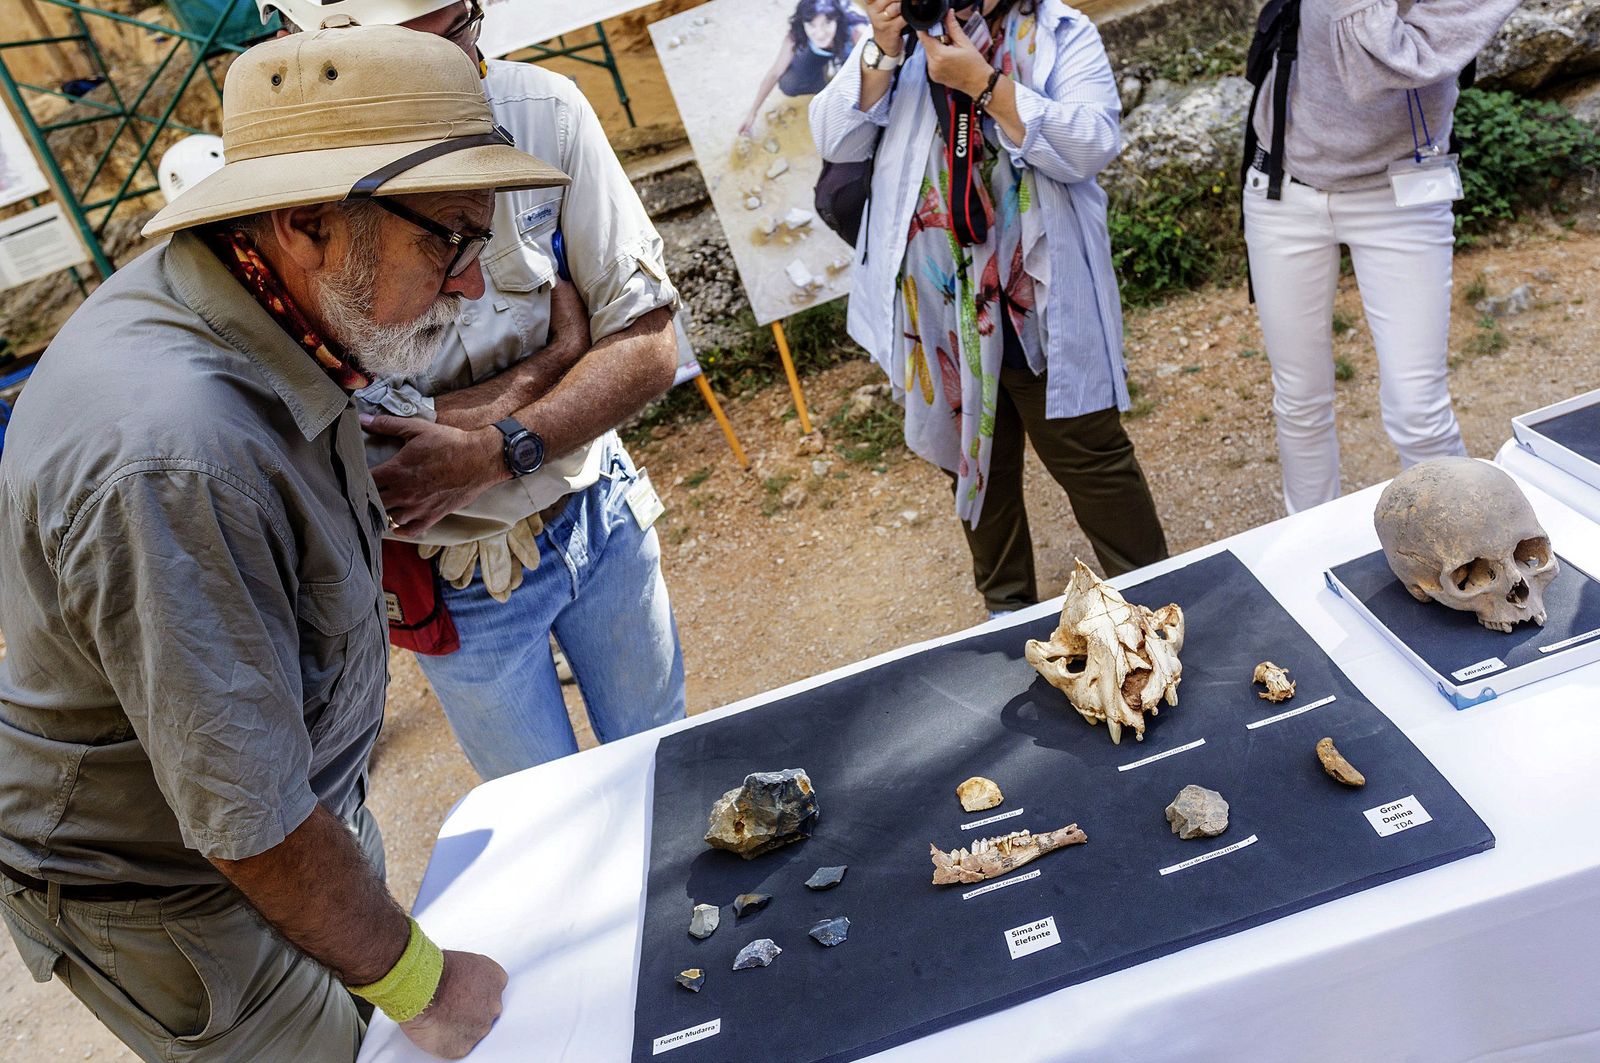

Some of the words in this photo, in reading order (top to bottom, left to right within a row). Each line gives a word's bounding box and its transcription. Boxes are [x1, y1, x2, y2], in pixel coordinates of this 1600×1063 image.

[955, 113, 968, 158] Canon
[1463, 664, 1493, 677] Mirador
[1379, 803, 1403, 814] Gran
[1382, 810, 1414, 824] Dolina
[1393, 819, 1414, 830] TD4
[1011, 927, 1033, 938] Sima
[1034, 920, 1049, 930] del
[1014, 930, 1051, 947] Elefante
[660, 1035, 683, 1045] Fuente
[685, 1025, 715, 1038] Mudarra
